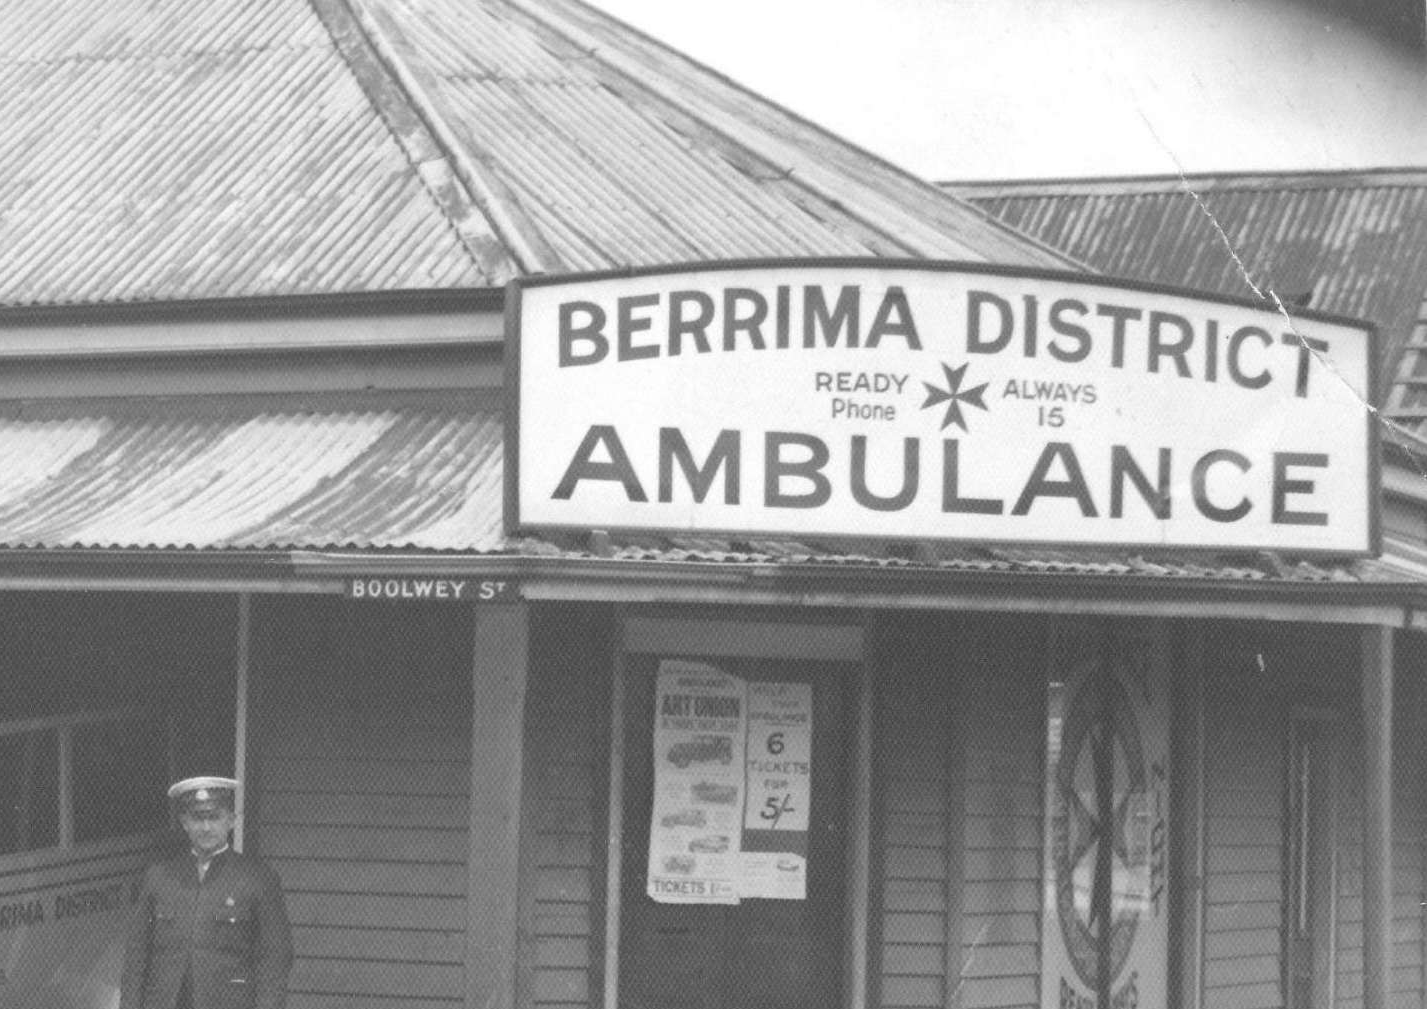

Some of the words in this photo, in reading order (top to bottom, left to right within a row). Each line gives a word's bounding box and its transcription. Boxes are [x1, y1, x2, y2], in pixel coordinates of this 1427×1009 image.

[557, 284, 922, 368] BERRIMA
[967, 289, 1329, 399] DISTRICT
[815, 371, 909, 394] READY
[1002, 379, 1098, 404] ALWAYS
[831, 398, 896, 422] Phone
[1038, 406, 1066, 428] 15
[550, 424, 1330, 526] AMBULANCE
[352, 579, 466, 599] BOOLWEY
[767, 732, 785, 755] 6
[747, 759, 809, 775] TICKETS
[654, 880, 706, 895] TICKETS
